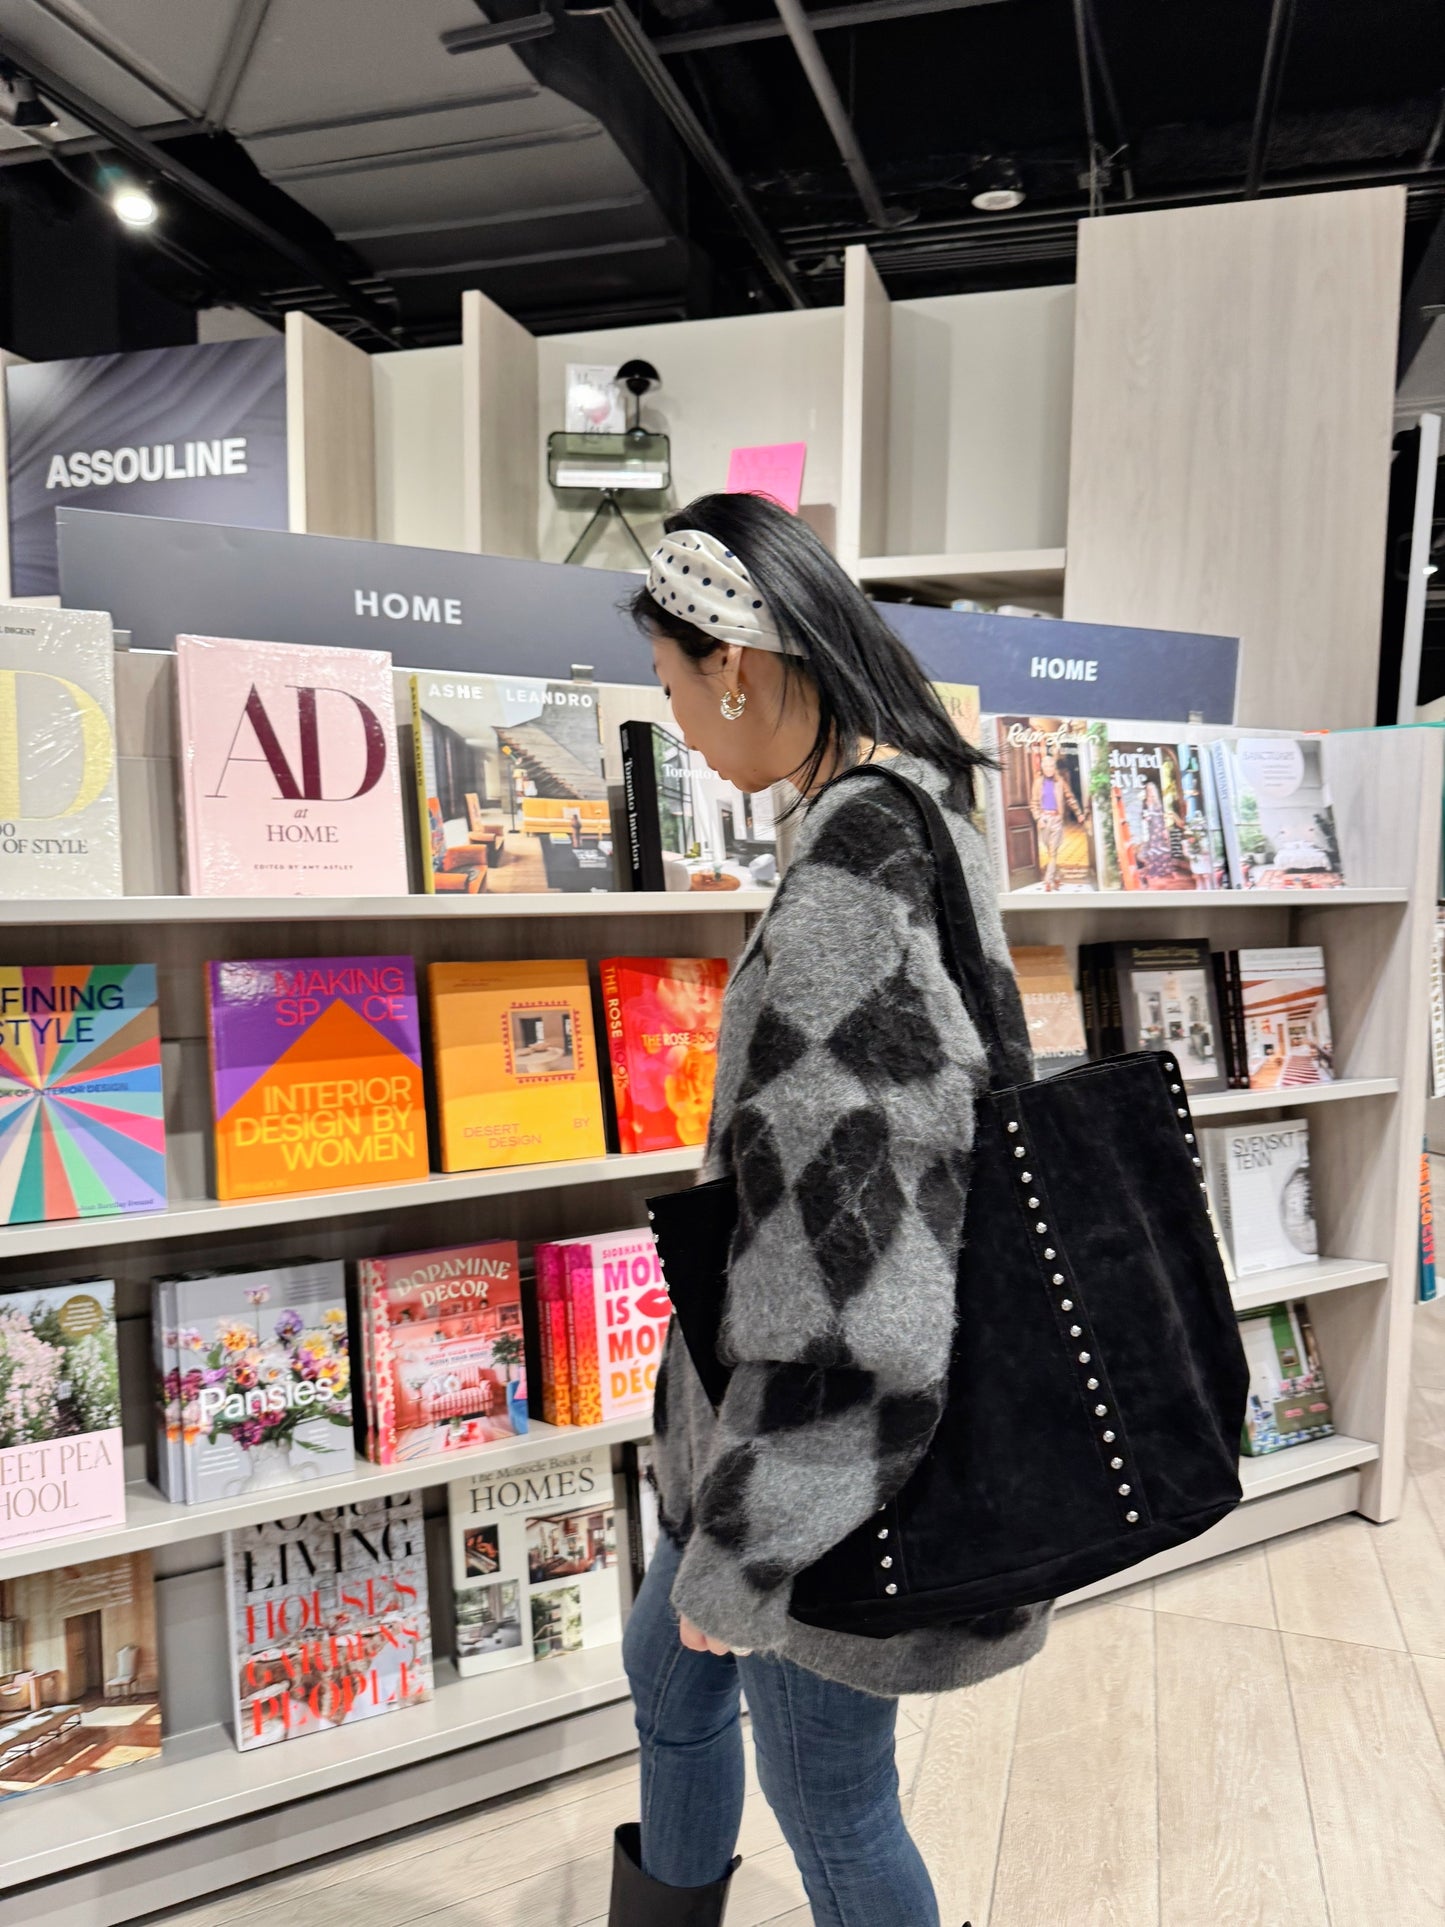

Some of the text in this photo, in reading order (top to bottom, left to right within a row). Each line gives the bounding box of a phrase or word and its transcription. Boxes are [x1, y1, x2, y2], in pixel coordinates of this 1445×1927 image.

[46, 437, 248, 489] ASSOULINE
[354, 589, 463, 625] HOME
[1030, 656, 1099, 682] HOME
[428, 683, 594, 708] ASHE LEANDRO
[204, 682, 387, 802] AD
[623, 757, 636, 811] Toronto
[661, 763, 712, 778] Toronto
[294, 808, 309, 819] at
[3, 838, 88, 854] OF STYLE
[265, 824, 339, 843] HOME
[628, 812, 641, 870] Interiors
[2, 984, 125, 1013] FINING
[274, 967, 405, 997] MAKING
[604, 966, 619, 996] THE
[0, 1017, 95, 1046] TYLE
[607, 998, 624, 1039] ROSE
[663, 1032, 690, 1046] ROSE
[264, 1076, 412, 1114] INTERIOR
[234, 1103, 414, 1147] DESIGN BY
[463, 1118, 591, 1138] DESERT BY
[488, 1134, 543, 1149] DESIGN
[281, 1131, 415, 1171] WOMEN
[1422, 1224, 1436, 1266] CITY
[394, 1257, 512, 1297] DOPAMINE
[420, 1279, 490, 1309] DECOR
[605, 1296, 630, 1327] IS
[200, 1374, 335, 1424] Pansies
[60, 1440, 112, 1476] PEA
[549, 1455, 579, 1470] Book
[469, 1467, 595, 1513] HOMES
[244, 1518, 413, 1593] LIVING
[245, 1570, 417, 1644] HOUSES
[252, 1657, 424, 1736] PEOPLE
